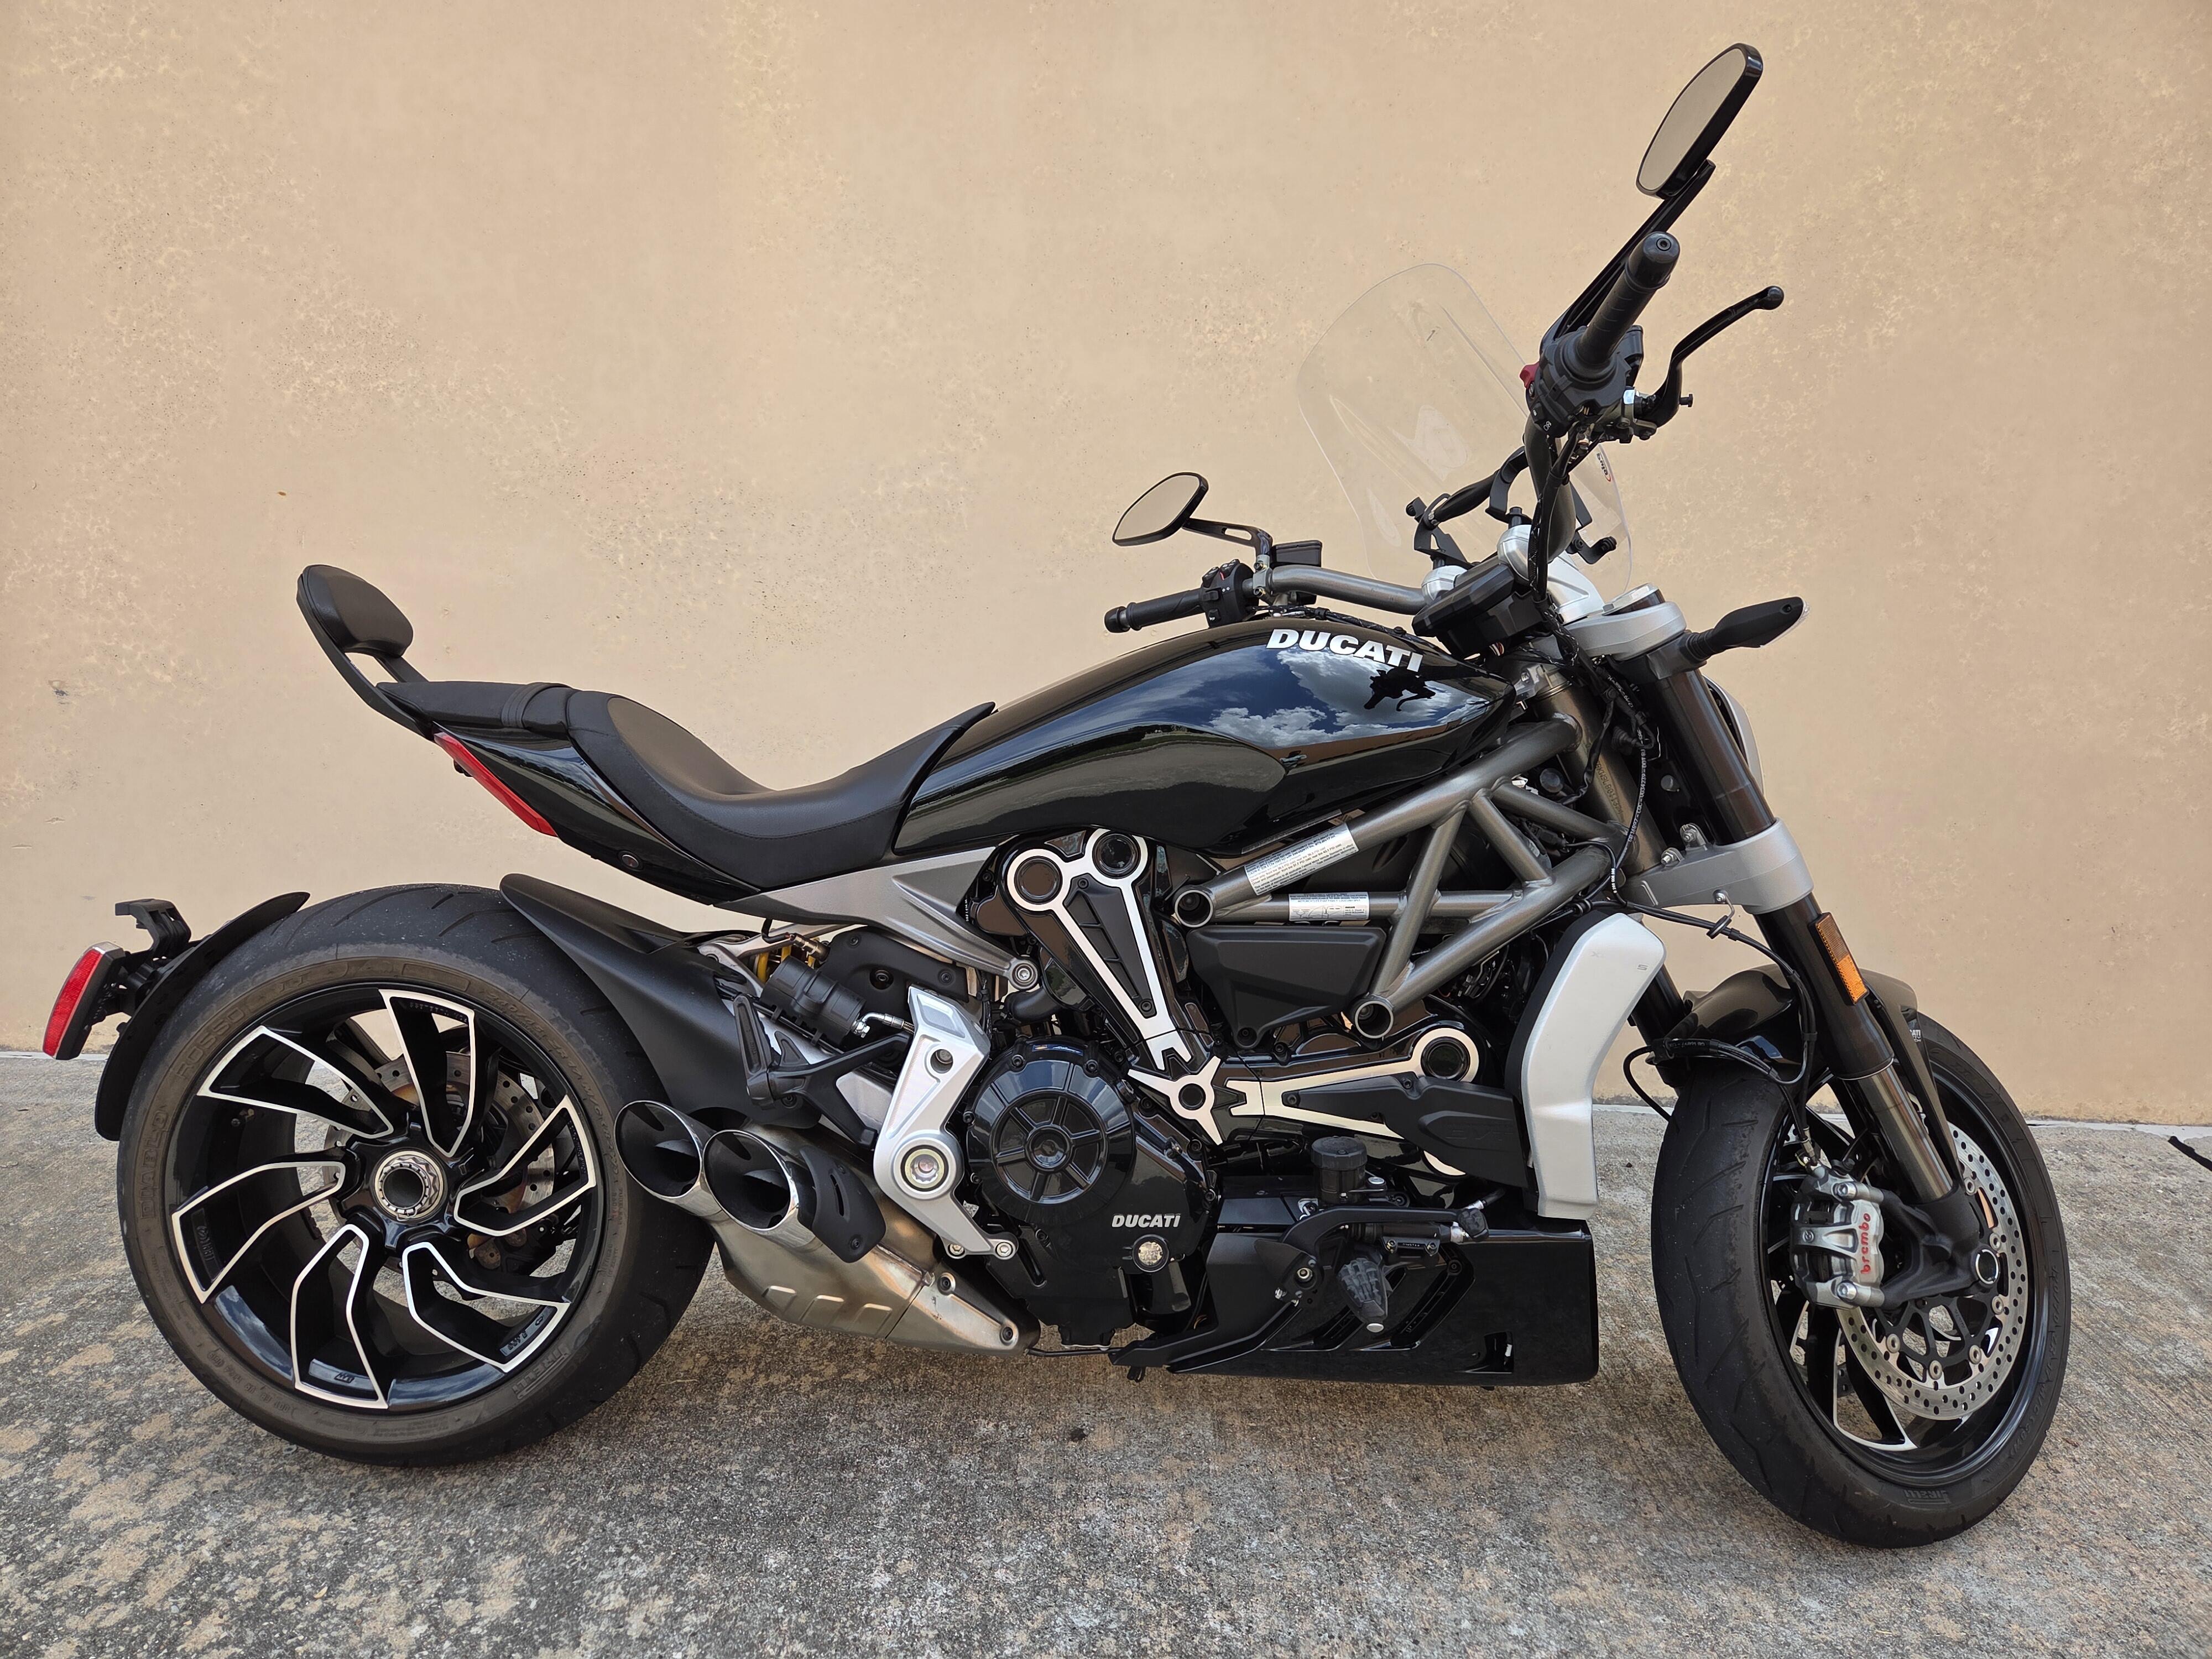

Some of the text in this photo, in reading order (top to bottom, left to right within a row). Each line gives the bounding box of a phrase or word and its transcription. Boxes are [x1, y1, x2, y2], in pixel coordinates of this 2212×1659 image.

[1266, 629, 1423, 672] DUCATI
[140, 1109, 170, 1220] DIABLO
[176, 1006, 246, 1079] ROSSO
[1112, 1213, 1181, 1228] DUCATI
[1859, 1213, 1871, 1274] brembo
[512, 1343, 571, 1399] PIRELLI
[1903, 1489, 1952, 1504] PIRELLI
